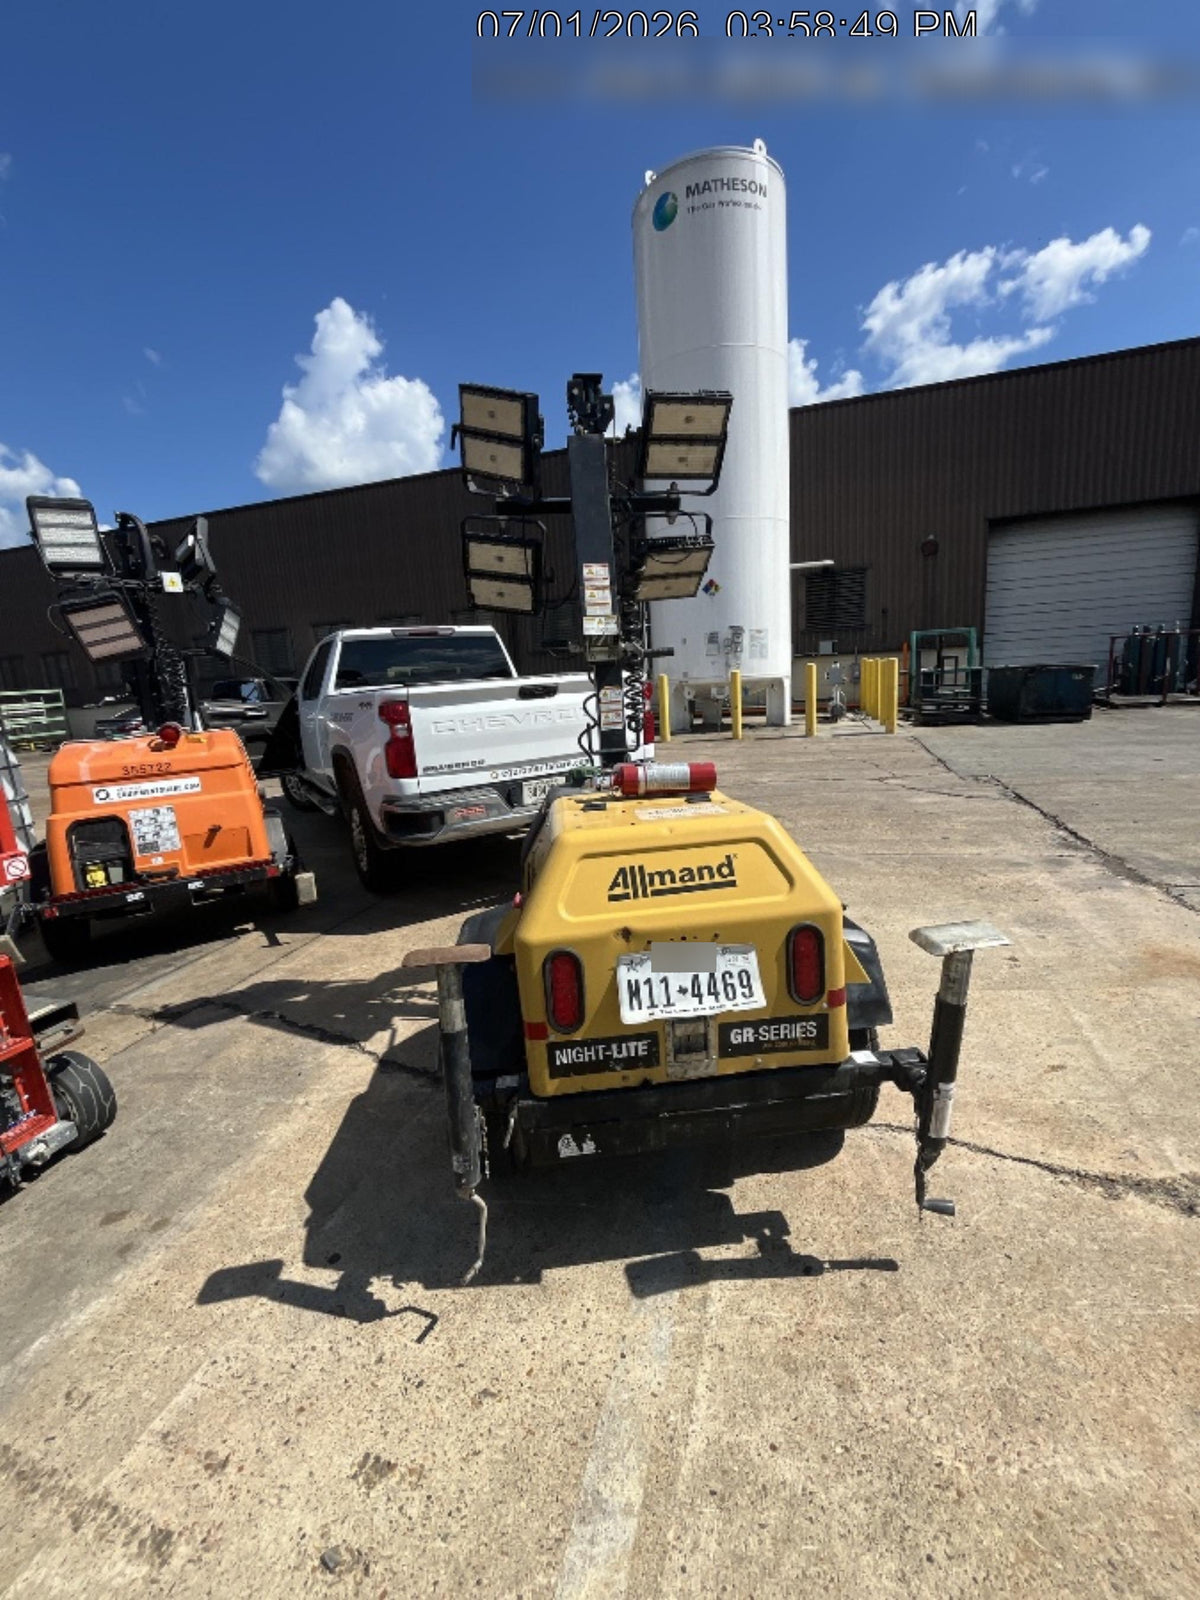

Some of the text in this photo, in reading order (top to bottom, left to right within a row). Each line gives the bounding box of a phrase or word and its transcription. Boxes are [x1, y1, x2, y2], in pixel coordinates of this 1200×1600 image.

[685, 177, 767, 198] MATHESON
[431, 708, 589, 735] CHEVRO
[608, 854, 736, 902] Allmand
[730, 1021, 817, 1045] GR-SERIES
[555, 1040, 651, 1066] NIGHT-LITE
